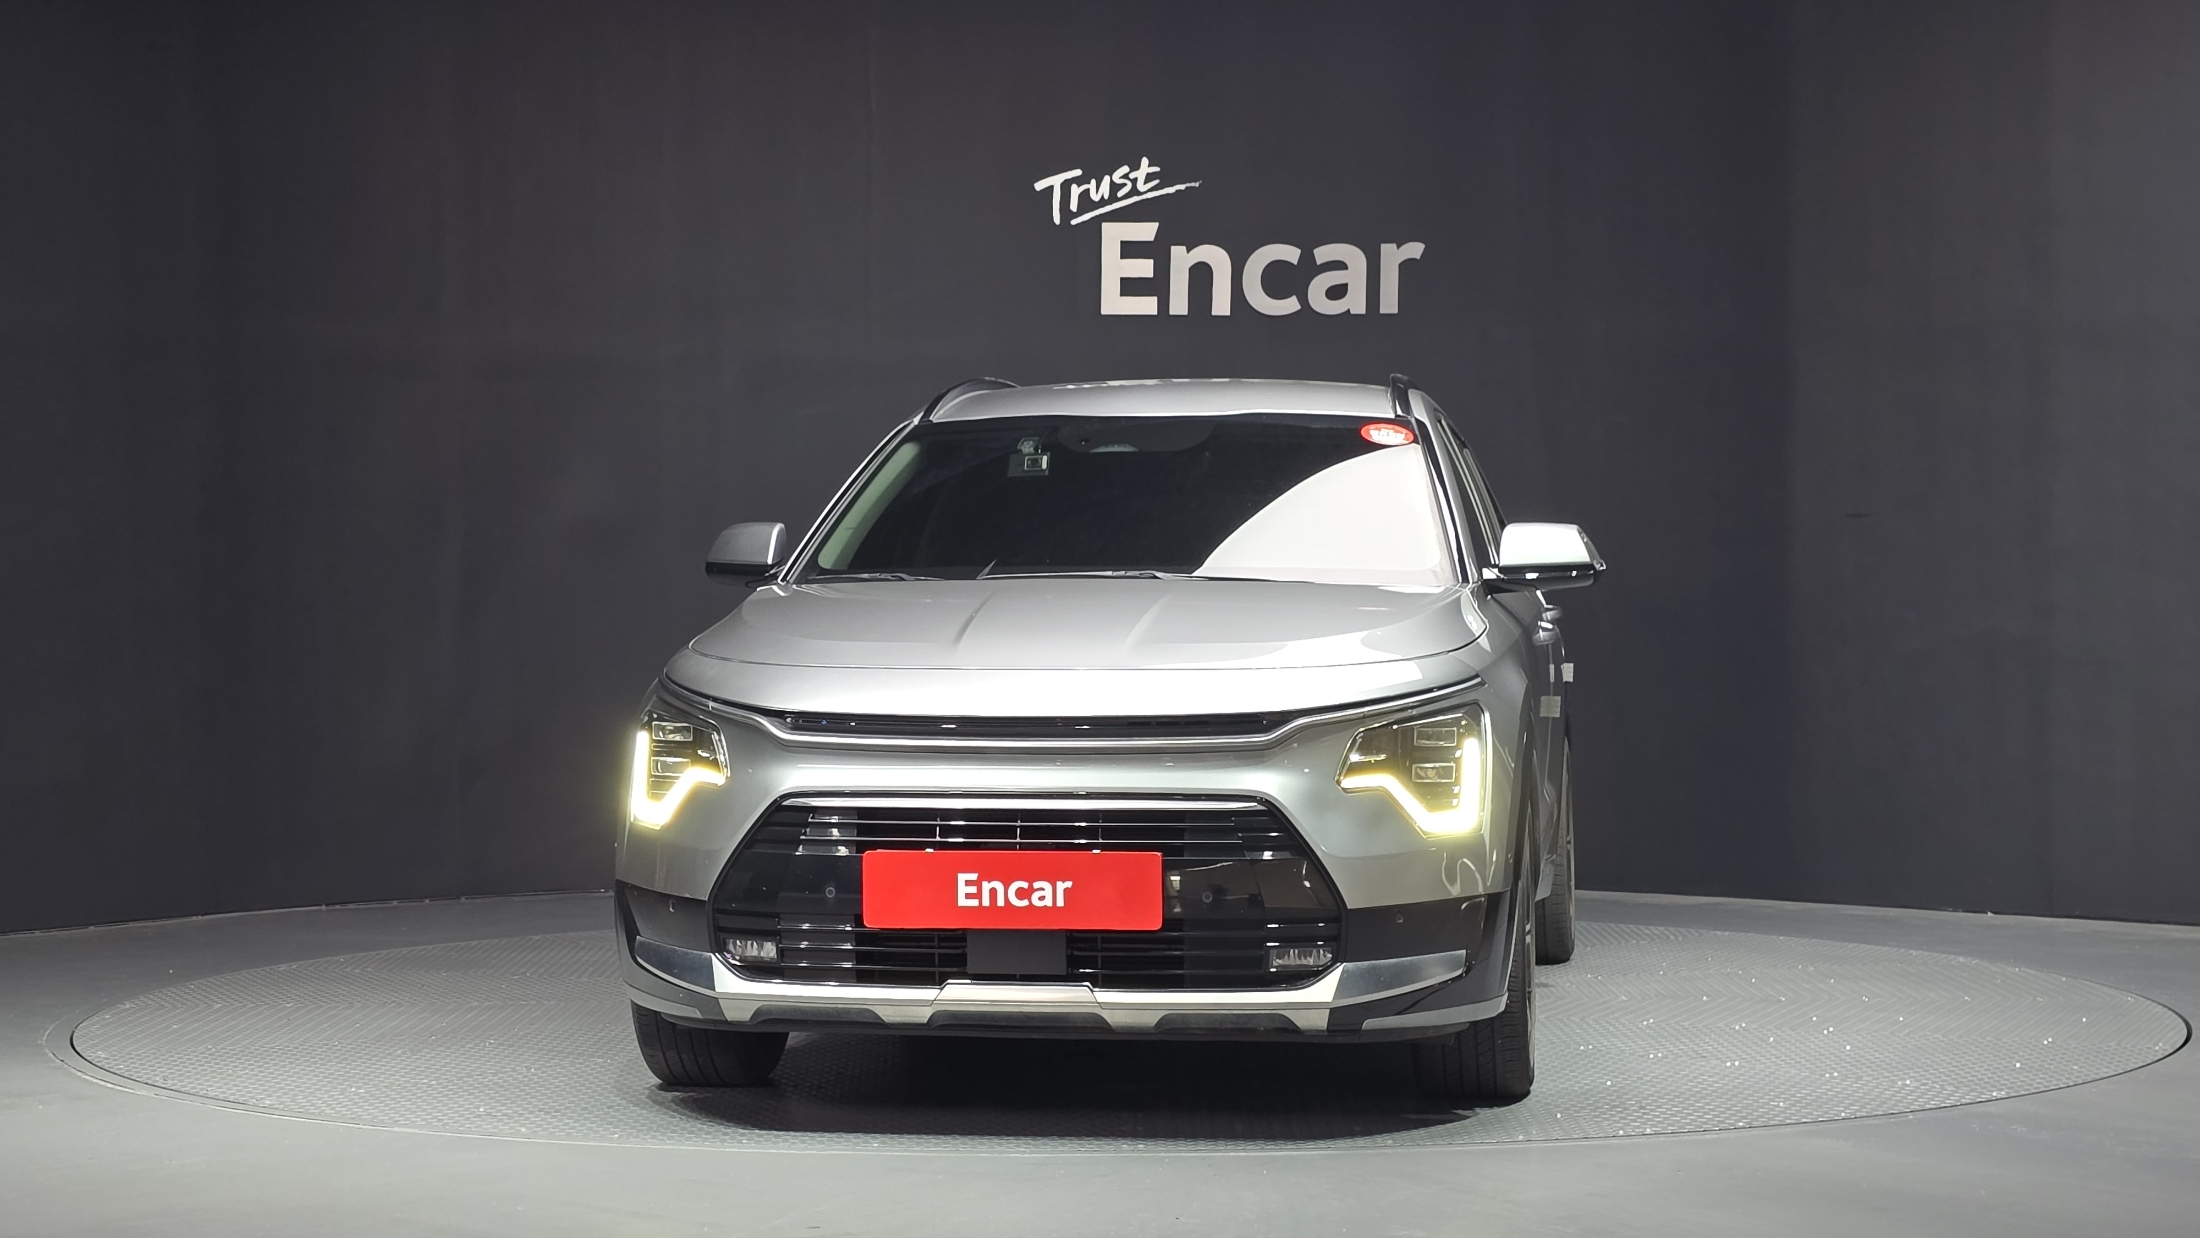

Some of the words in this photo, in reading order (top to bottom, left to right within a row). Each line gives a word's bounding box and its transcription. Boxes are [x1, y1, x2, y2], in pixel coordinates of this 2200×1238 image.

[1034, 156, 1161, 226] Trust
[1100, 221, 1426, 316] Encar
[956, 872, 1073, 908] Encar
